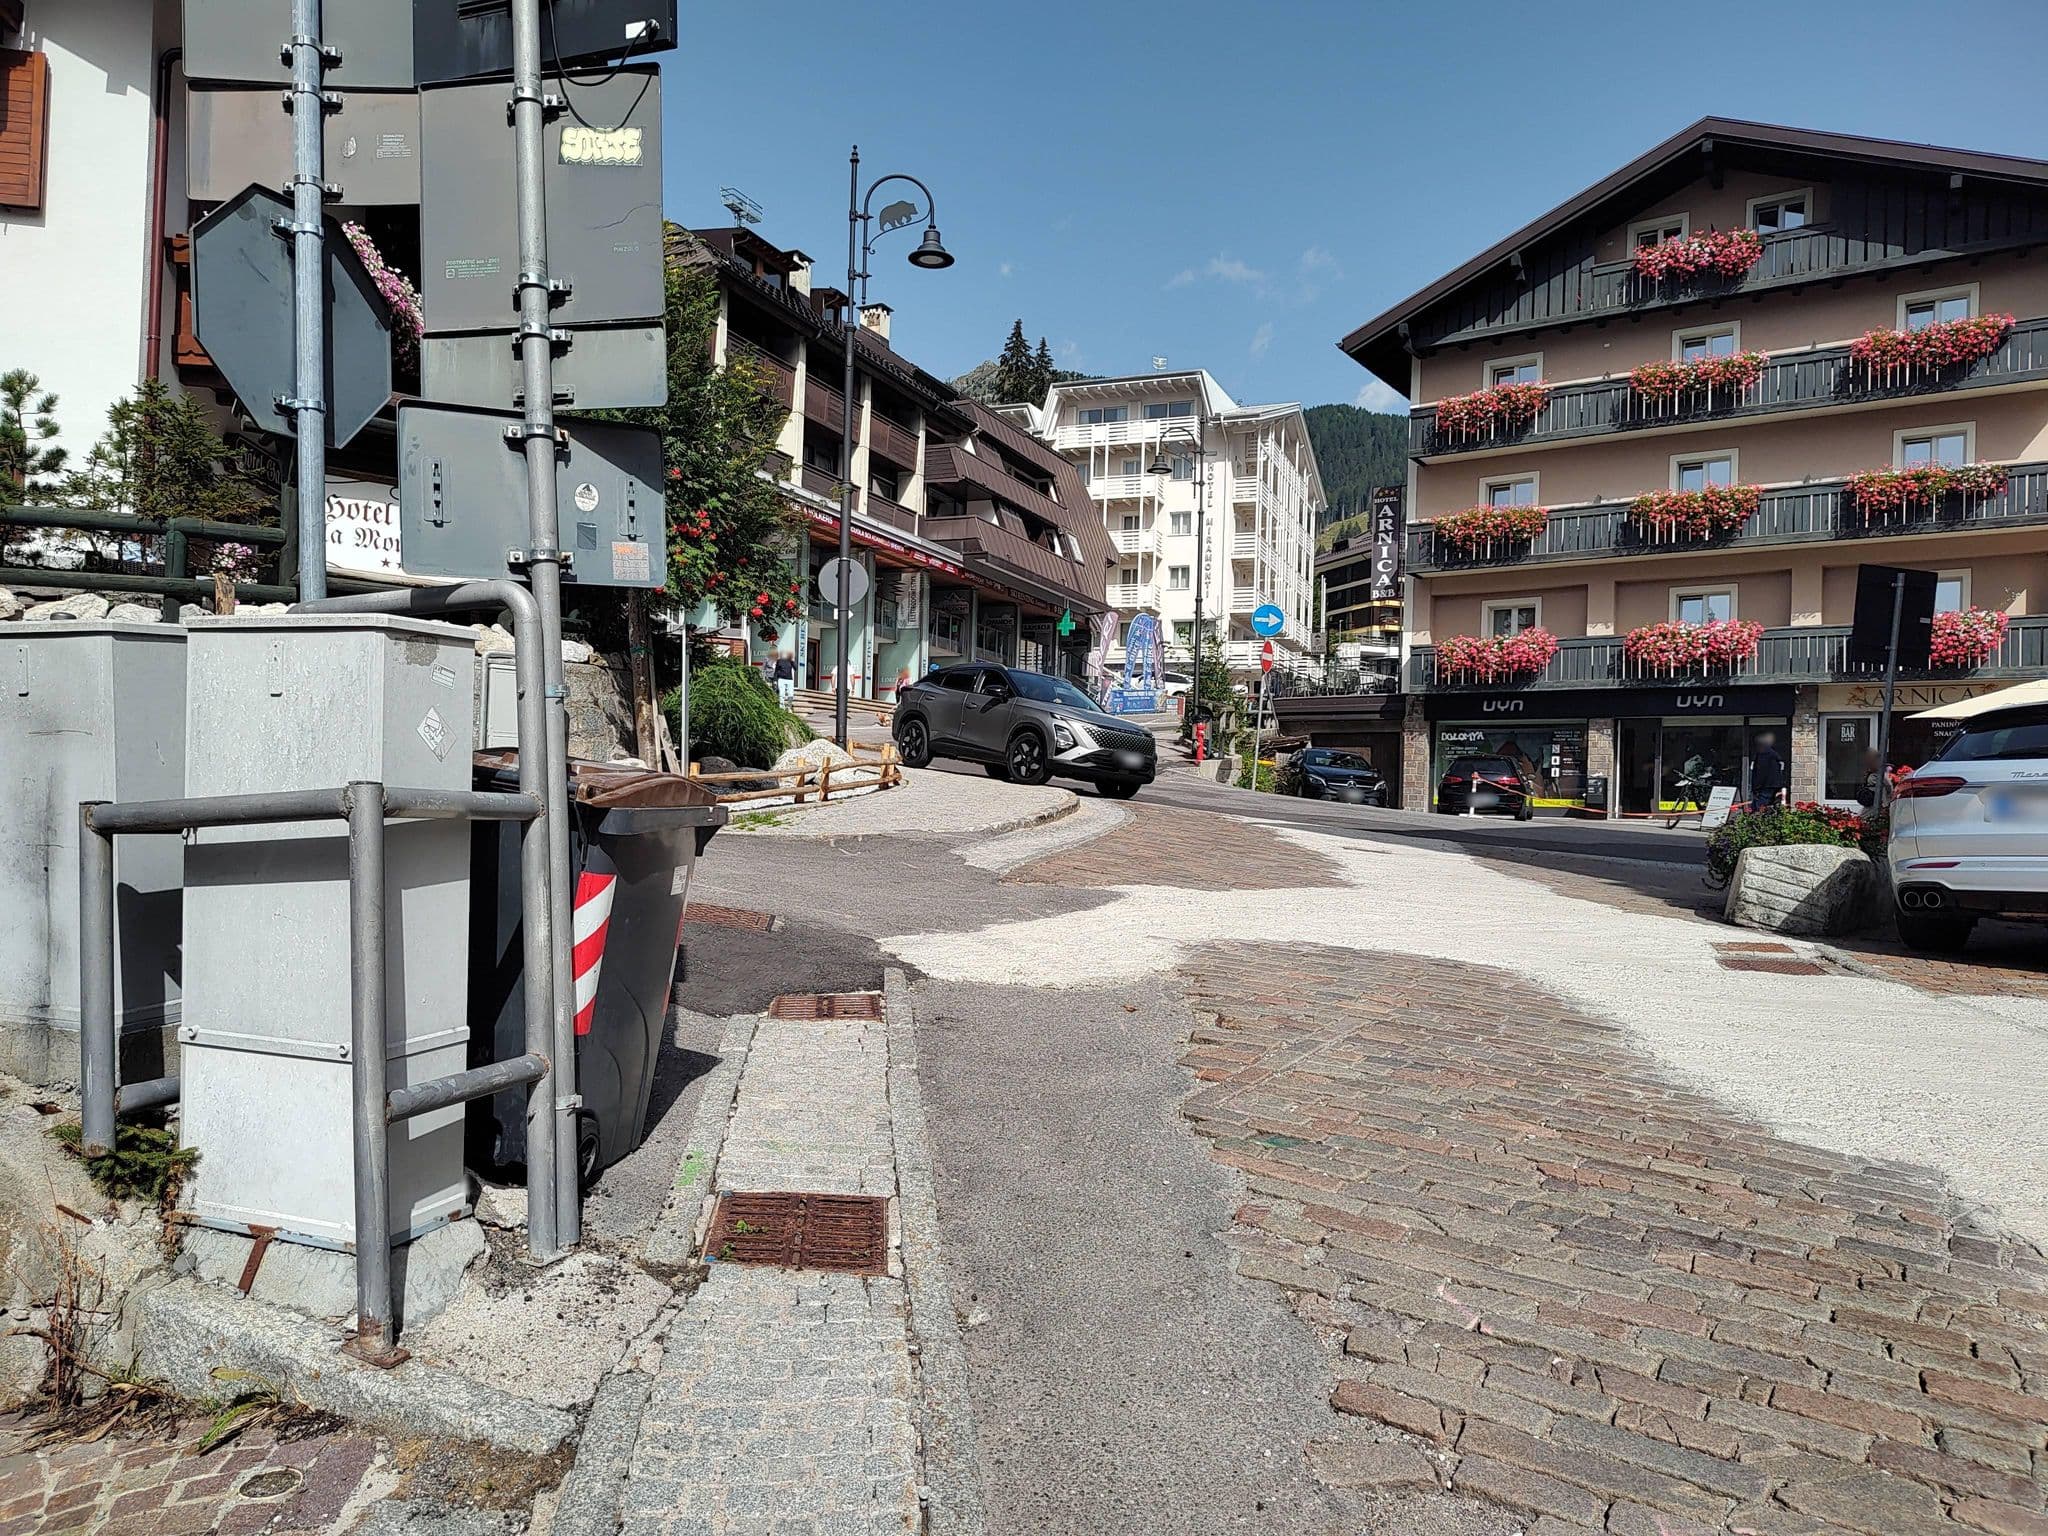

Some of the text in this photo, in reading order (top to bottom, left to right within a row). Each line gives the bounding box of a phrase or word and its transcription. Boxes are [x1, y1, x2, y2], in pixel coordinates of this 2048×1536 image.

[326, 494, 393, 525] Hotel
[1375, 504, 1396, 587] ARNICA
[1372, 589, 1396, 599] B&B
[1676, 695, 1724, 707] UYN
[1872, 687, 1976, 706] ARNICA
[1483, 700, 1524, 711] UYN
[1841, 726, 1856, 738] BAR
